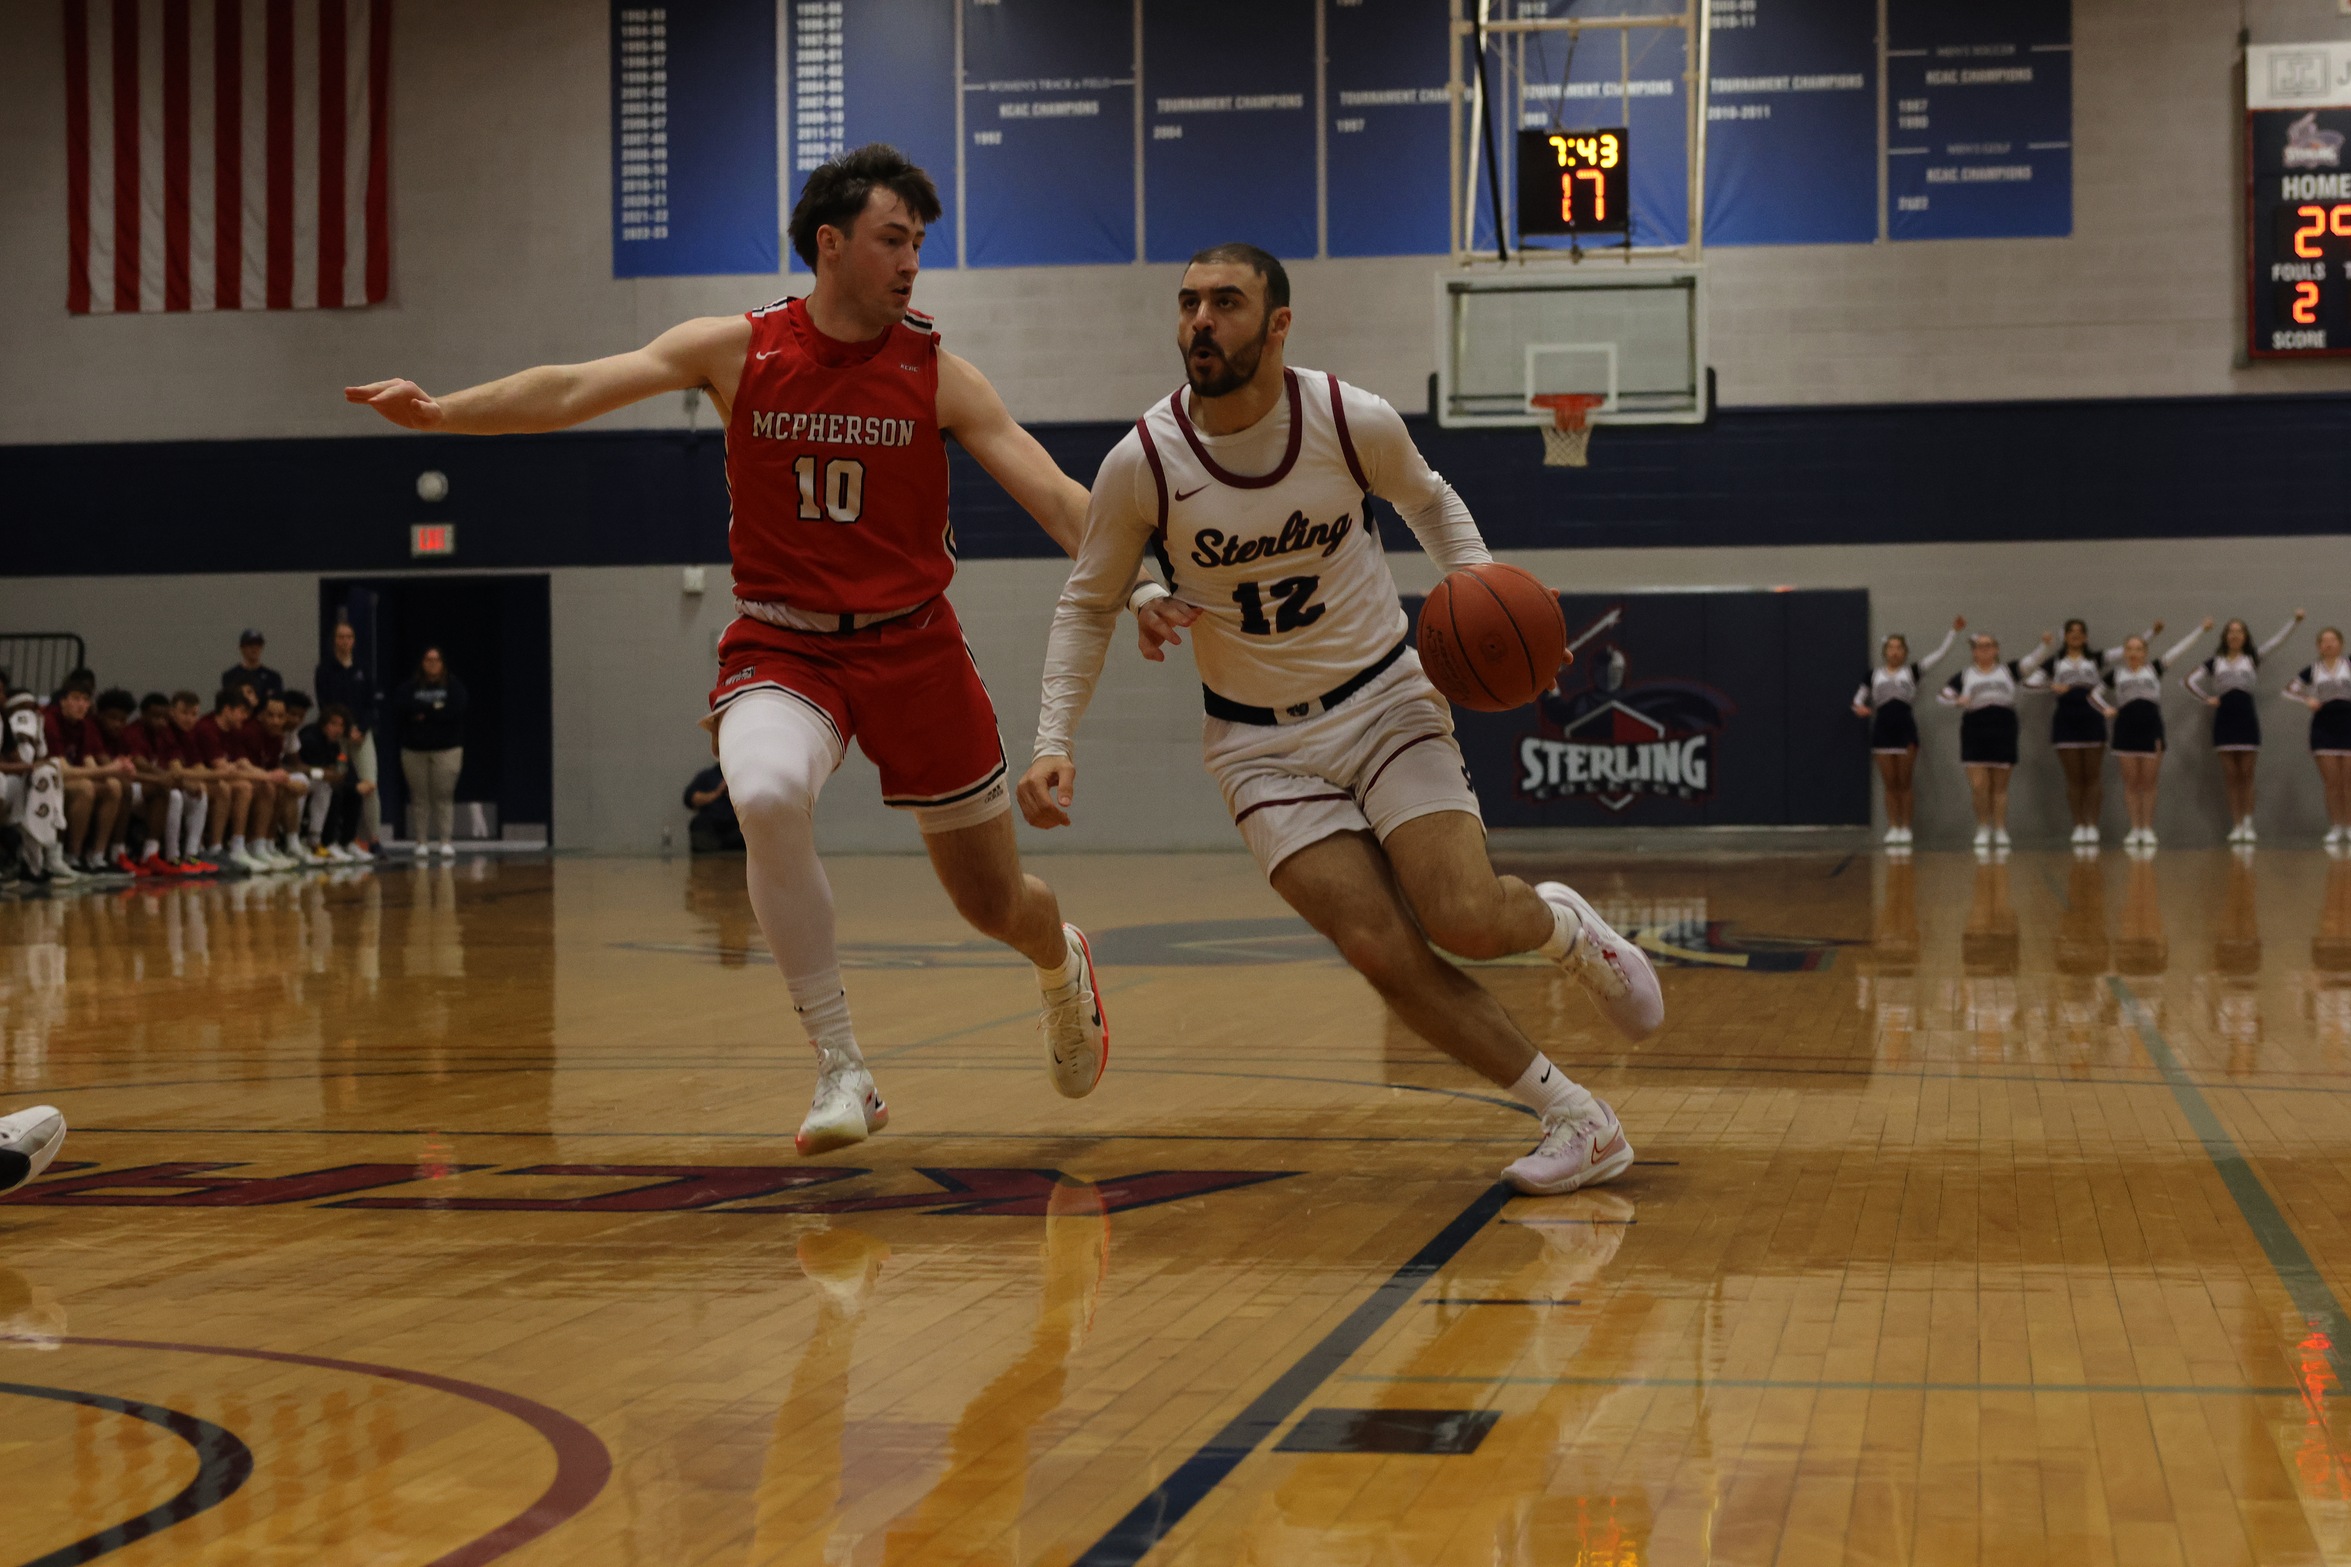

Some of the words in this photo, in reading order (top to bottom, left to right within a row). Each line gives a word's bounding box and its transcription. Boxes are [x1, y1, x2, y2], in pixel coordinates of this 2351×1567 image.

[1711, 76, 1790, 94] TOURNAMENT
[1791, 73, 1864, 91] CHAMPIONS
[1960, 66, 2033, 84] CHAMPIONS
[1031, 100, 1099, 117] CHAMPIONS
[1156, 97, 1233, 113] TOURNAMENT
[1234, 93, 1303, 111] CHAMPIONS
[1339, 89, 1416, 106] TOURNAMENT
[1548, 133, 1619, 168] 7:43
[1960, 165, 2033, 182] CHAMPIONS
[2281, 172, 2351, 200] HOME
[1561, 168, 1606, 222] 17
[2271, 262, 2326, 281] FOULS
[2292, 281, 2320, 324] 2
[2272, 330, 2327, 350] SCORE
[752, 410, 915, 447] MCPHERSON
[792, 455, 866, 523] 10
[1191, 509, 1353, 569] Sterling
[1232, 575, 1326, 635] 12
[1521, 735, 1707, 791] STERLING
[0, 1161, 1307, 1217] KCA
